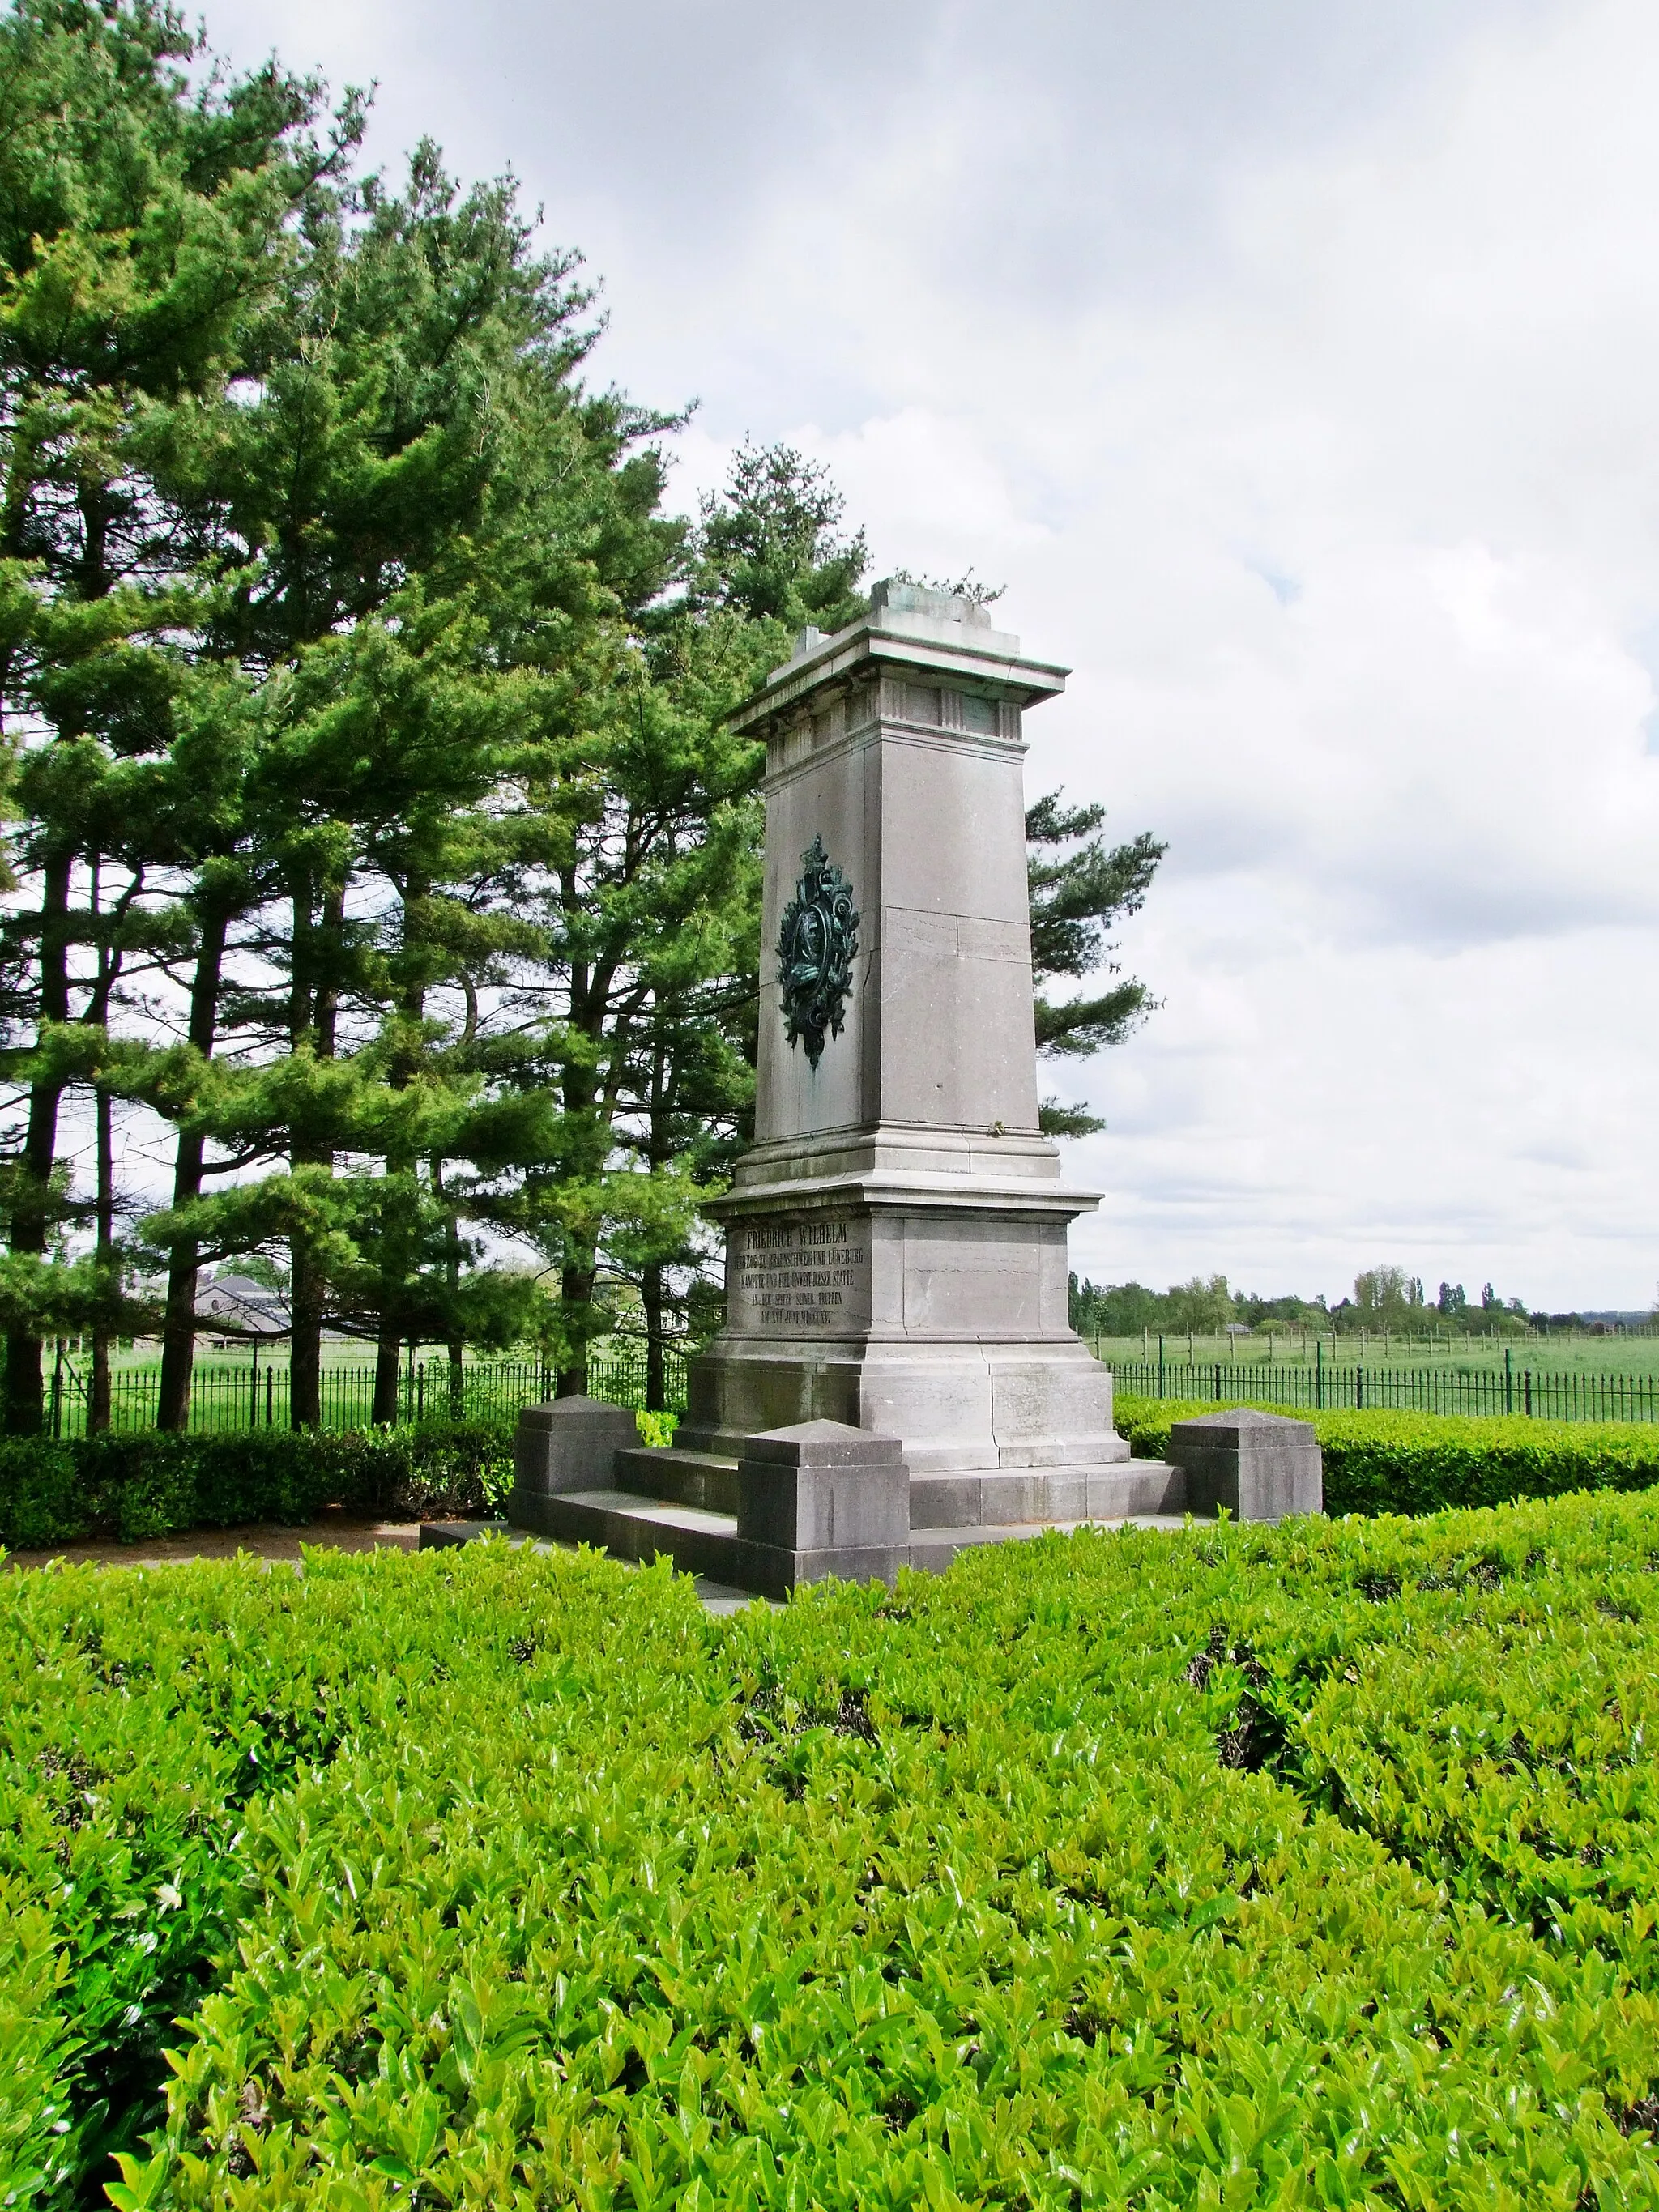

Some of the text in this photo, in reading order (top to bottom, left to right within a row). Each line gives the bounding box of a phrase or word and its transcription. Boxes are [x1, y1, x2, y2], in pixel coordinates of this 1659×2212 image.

[747, 1223, 847, 1250] FRIEDRICH WILHELM
[812, 1250, 825, 1266] UND
[828, 1247, 863, 1264] LÜNEBURG
